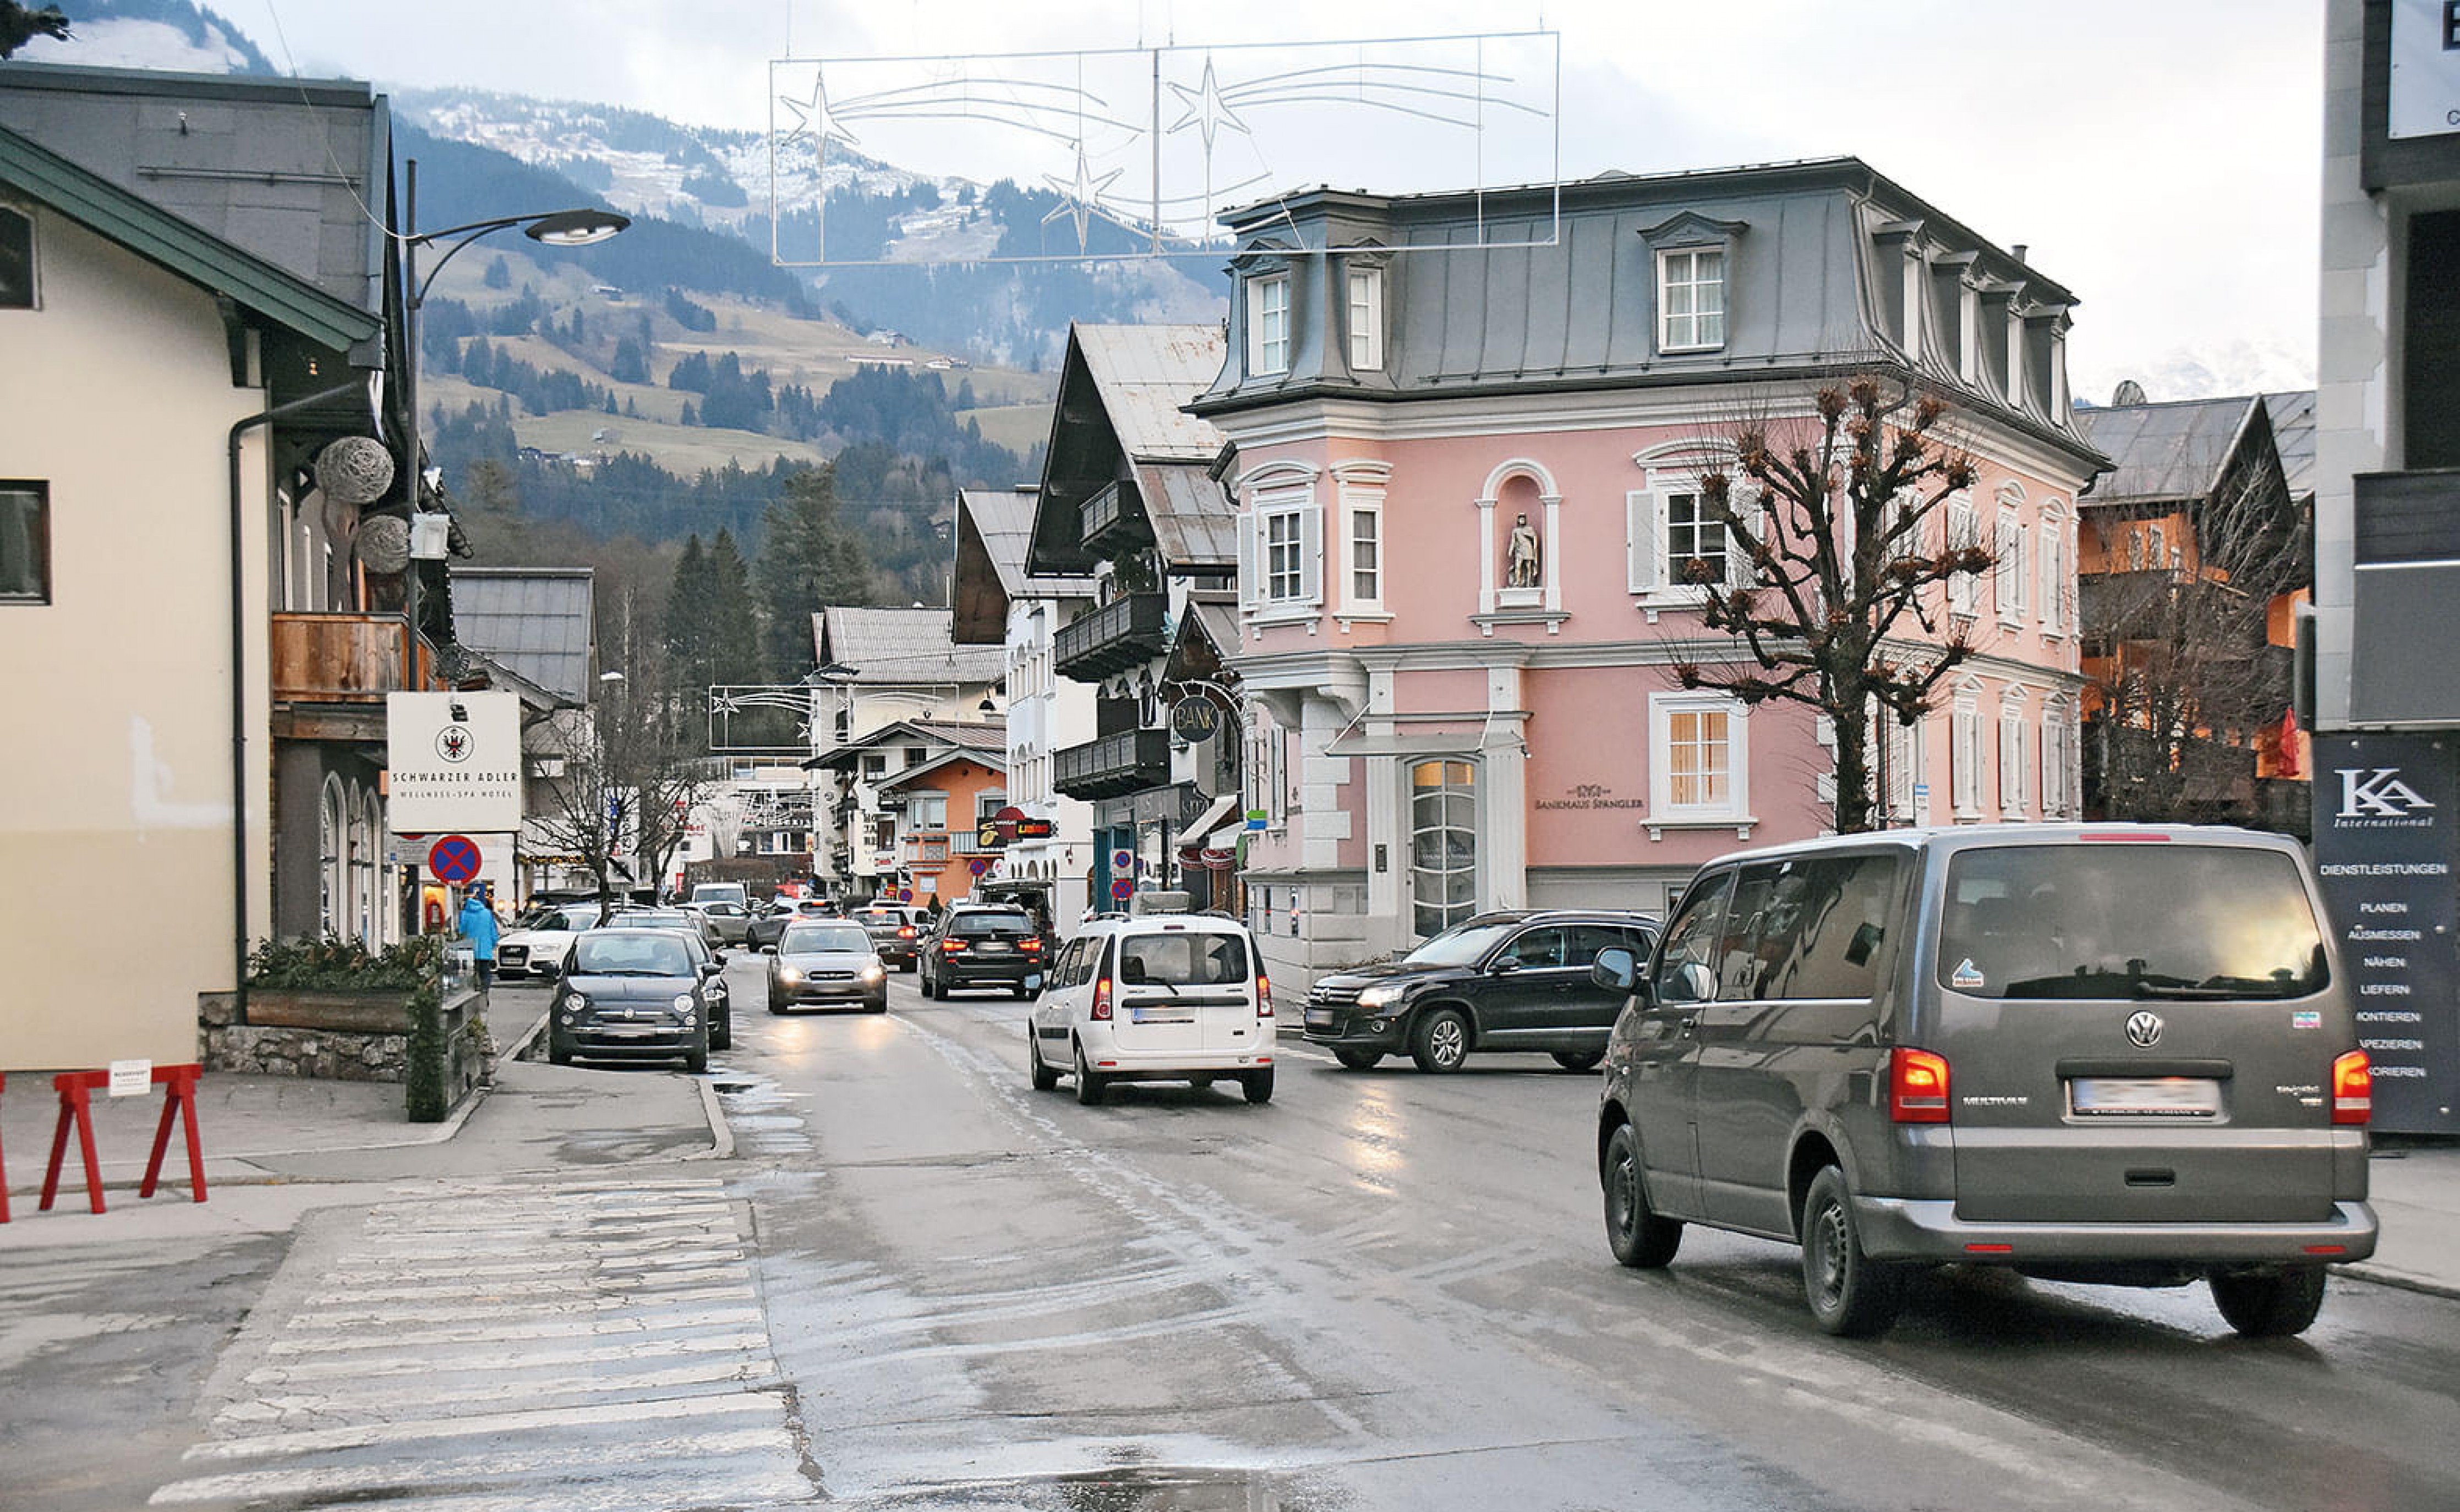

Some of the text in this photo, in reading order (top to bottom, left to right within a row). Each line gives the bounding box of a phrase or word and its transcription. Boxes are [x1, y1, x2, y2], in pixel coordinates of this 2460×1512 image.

[393, 773, 517, 782] SCHWARZER ADLER
[2333, 769, 2436, 817] KA
[2320, 864, 2448, 875] DIENSTLEISTUNGEN
[2360, 903, 2408, 912] PLANEN
[2348, 930, 2421, 940] AUSMESSEN
[2360, 984, 2410, 994] LIEFERN
[2360, 1039, 2423, 1049] PEZIEREN
